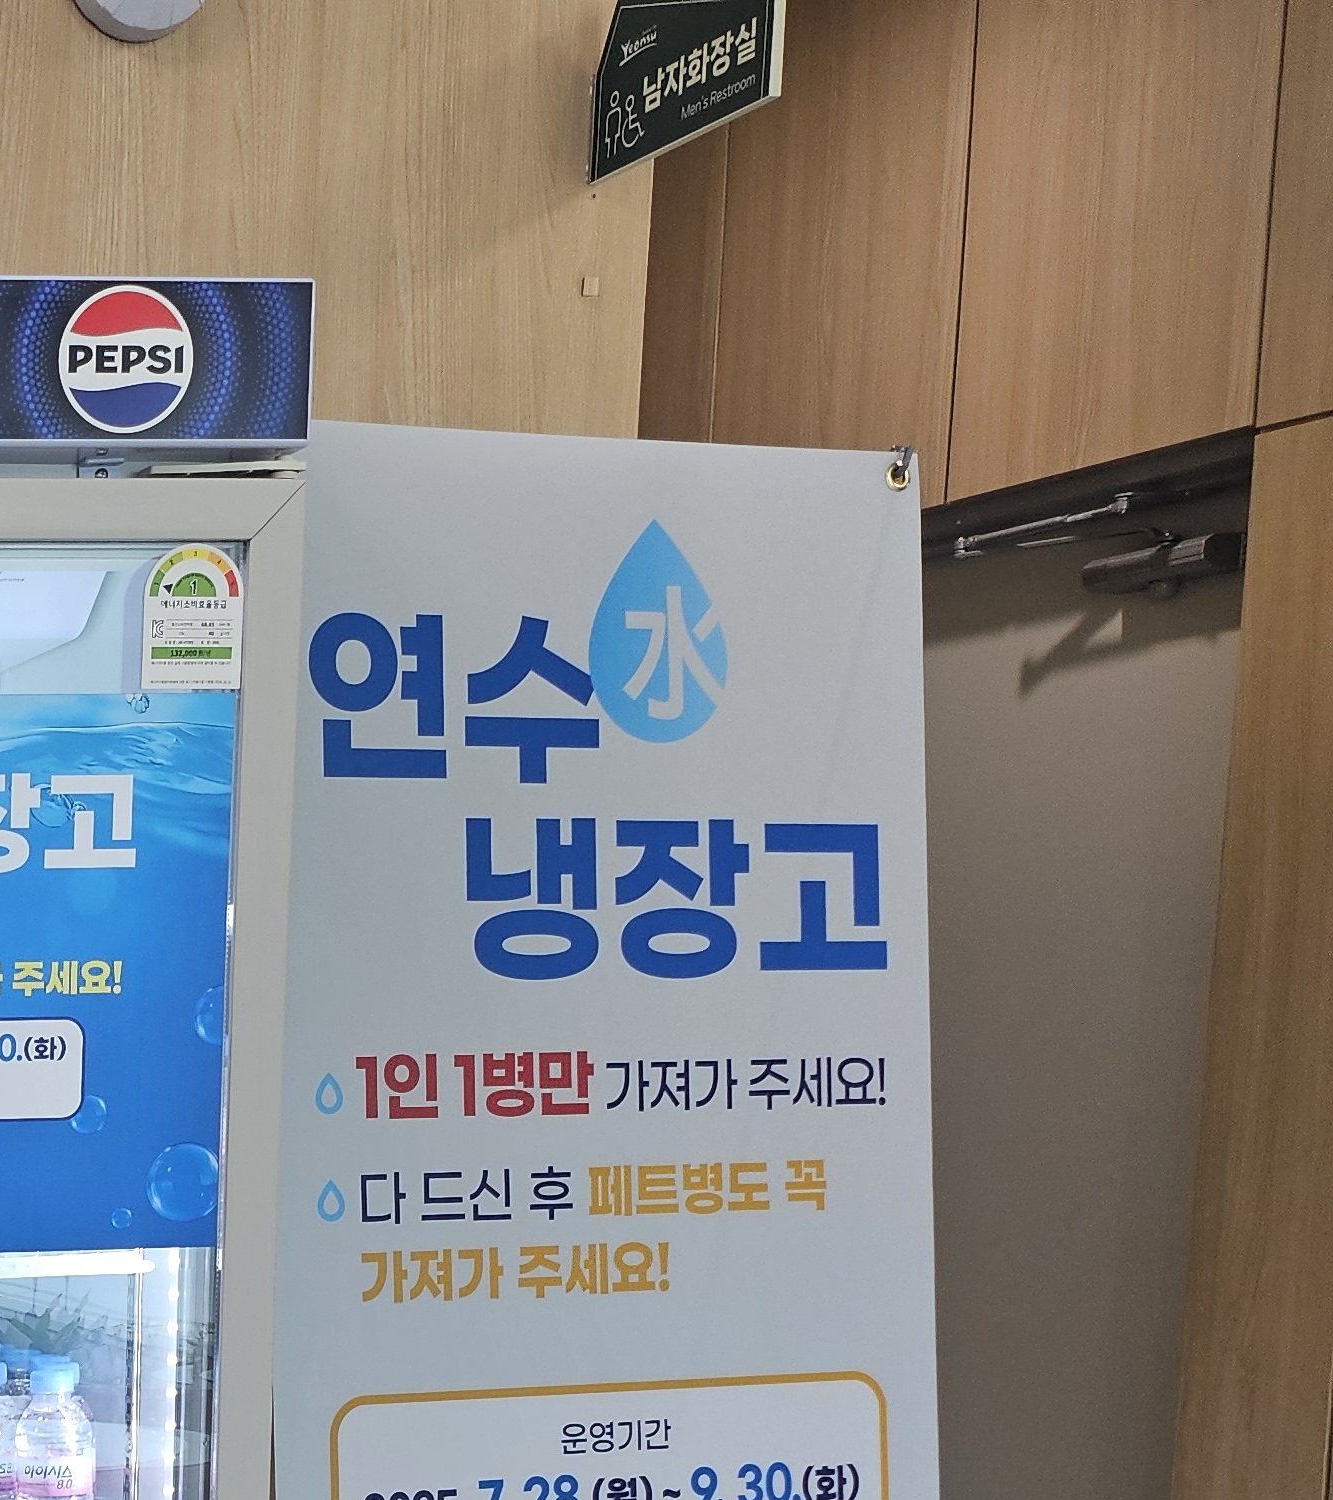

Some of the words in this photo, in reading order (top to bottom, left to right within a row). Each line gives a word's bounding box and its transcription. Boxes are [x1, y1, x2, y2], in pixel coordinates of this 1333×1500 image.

[621, 31, 657, 60] Yeonsu
[643, 17, 757, 113] 남자화장실
[681, 96, 708, 120] Men's
[710, 74, 756, 106] Restroom
[68, 345, 184, 374] PEPSI
[190, 579, 198, 595] 1
[465, 817, 888, 981] 냉장고
[11, 960, 122, 996] 주세요!
[355, 1053, 439, 1120] 1인
[453, 1050, 595, 1118] 1병만
[606, 1057, 737, 1112] 가져가
[747, 1057, 887, 1111] 주세요!
[360, 1171, 407, 1225] 다
[421, 1168, 513, 1222] 드신
[529, 1165, 574, 1220] 후
[588, 1160, 770, 1217] 페트병도
[784, 1159, 827, 1211] 꼭
[360, 1246, 504, 1304] 가져가
[517, 1241, 671, 1300] 주세요!
[560, 1418, 672, 1455] 운영기간
